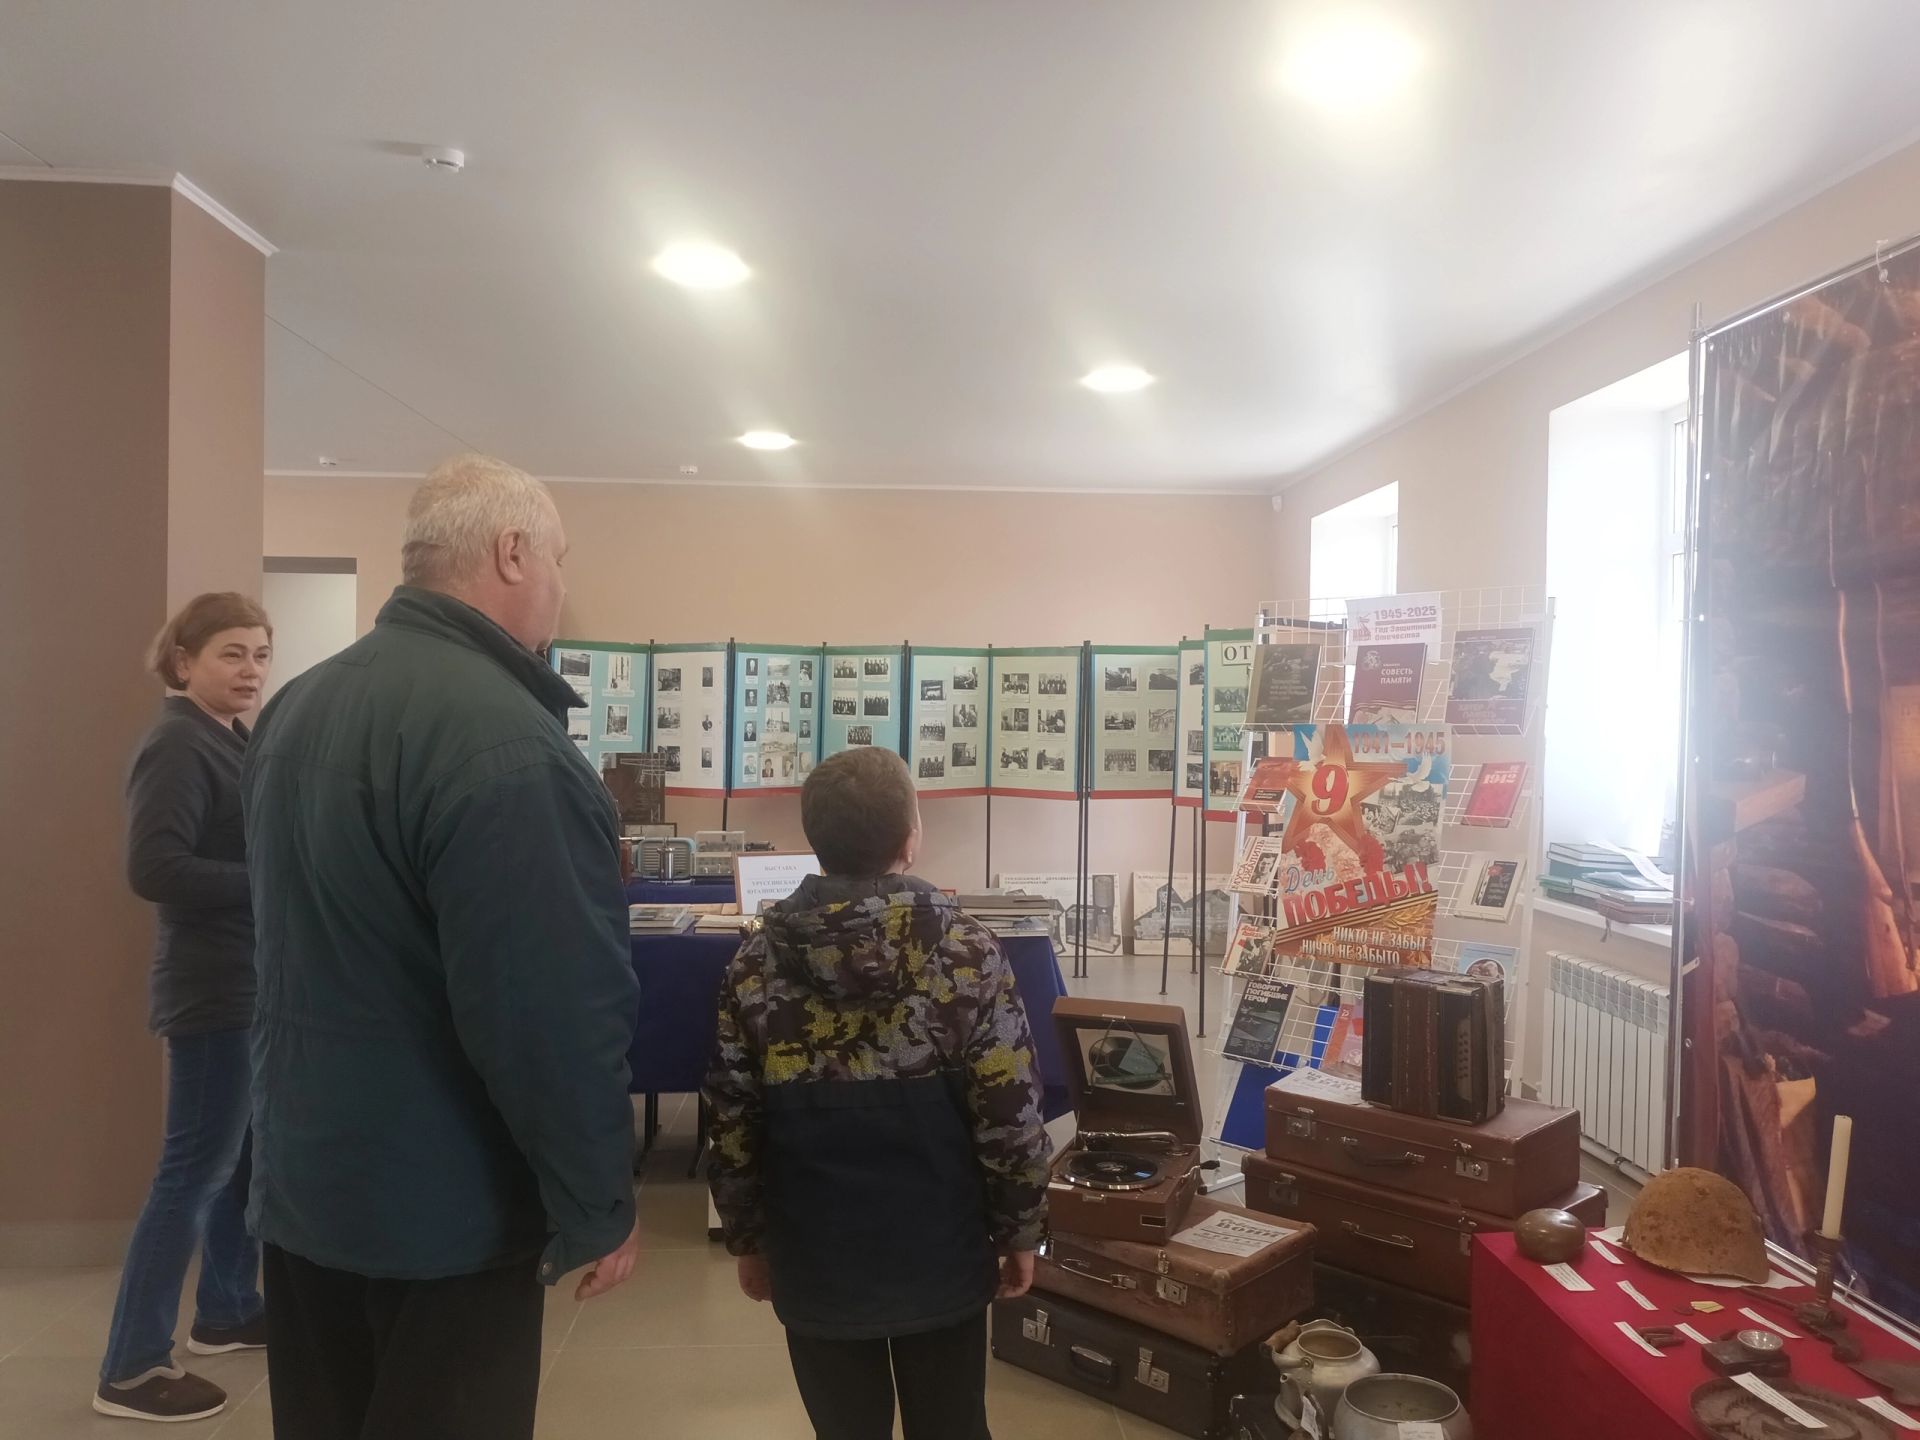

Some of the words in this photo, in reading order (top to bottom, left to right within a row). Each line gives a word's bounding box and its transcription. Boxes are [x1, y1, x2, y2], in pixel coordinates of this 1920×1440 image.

[1373, 605, 1437, 620] 1945-2025
[1381, 668, 1413, 676] СОВЕСТЬ
[1380, 676, 1412, 685] ПАМЯТИ
[1311, 764, 1350, 816] 9
[1285, 865, 1335, 893] День
[1283, 861, 1433, 929] ПОБЕДЫ!
[1333, 926, 1368, 944] НИКТО
[1372, 928, 1385, 945] НЕ
[1390, 931, 1428, 951] ЗАБЫТ
[1302, 939, 1335, 957] НИЧТО
[1339, 944, 1351, 959] НЕ
[1355, 946, 1400, 965] ЗАБЫТО
[1248, 981, 1282, 992] ГОВОРЯТ
[1244, 995, 1269, 1004] ГЕРОИ
[1246, 988, 1289, 1001] ПОГИБШИЕ
